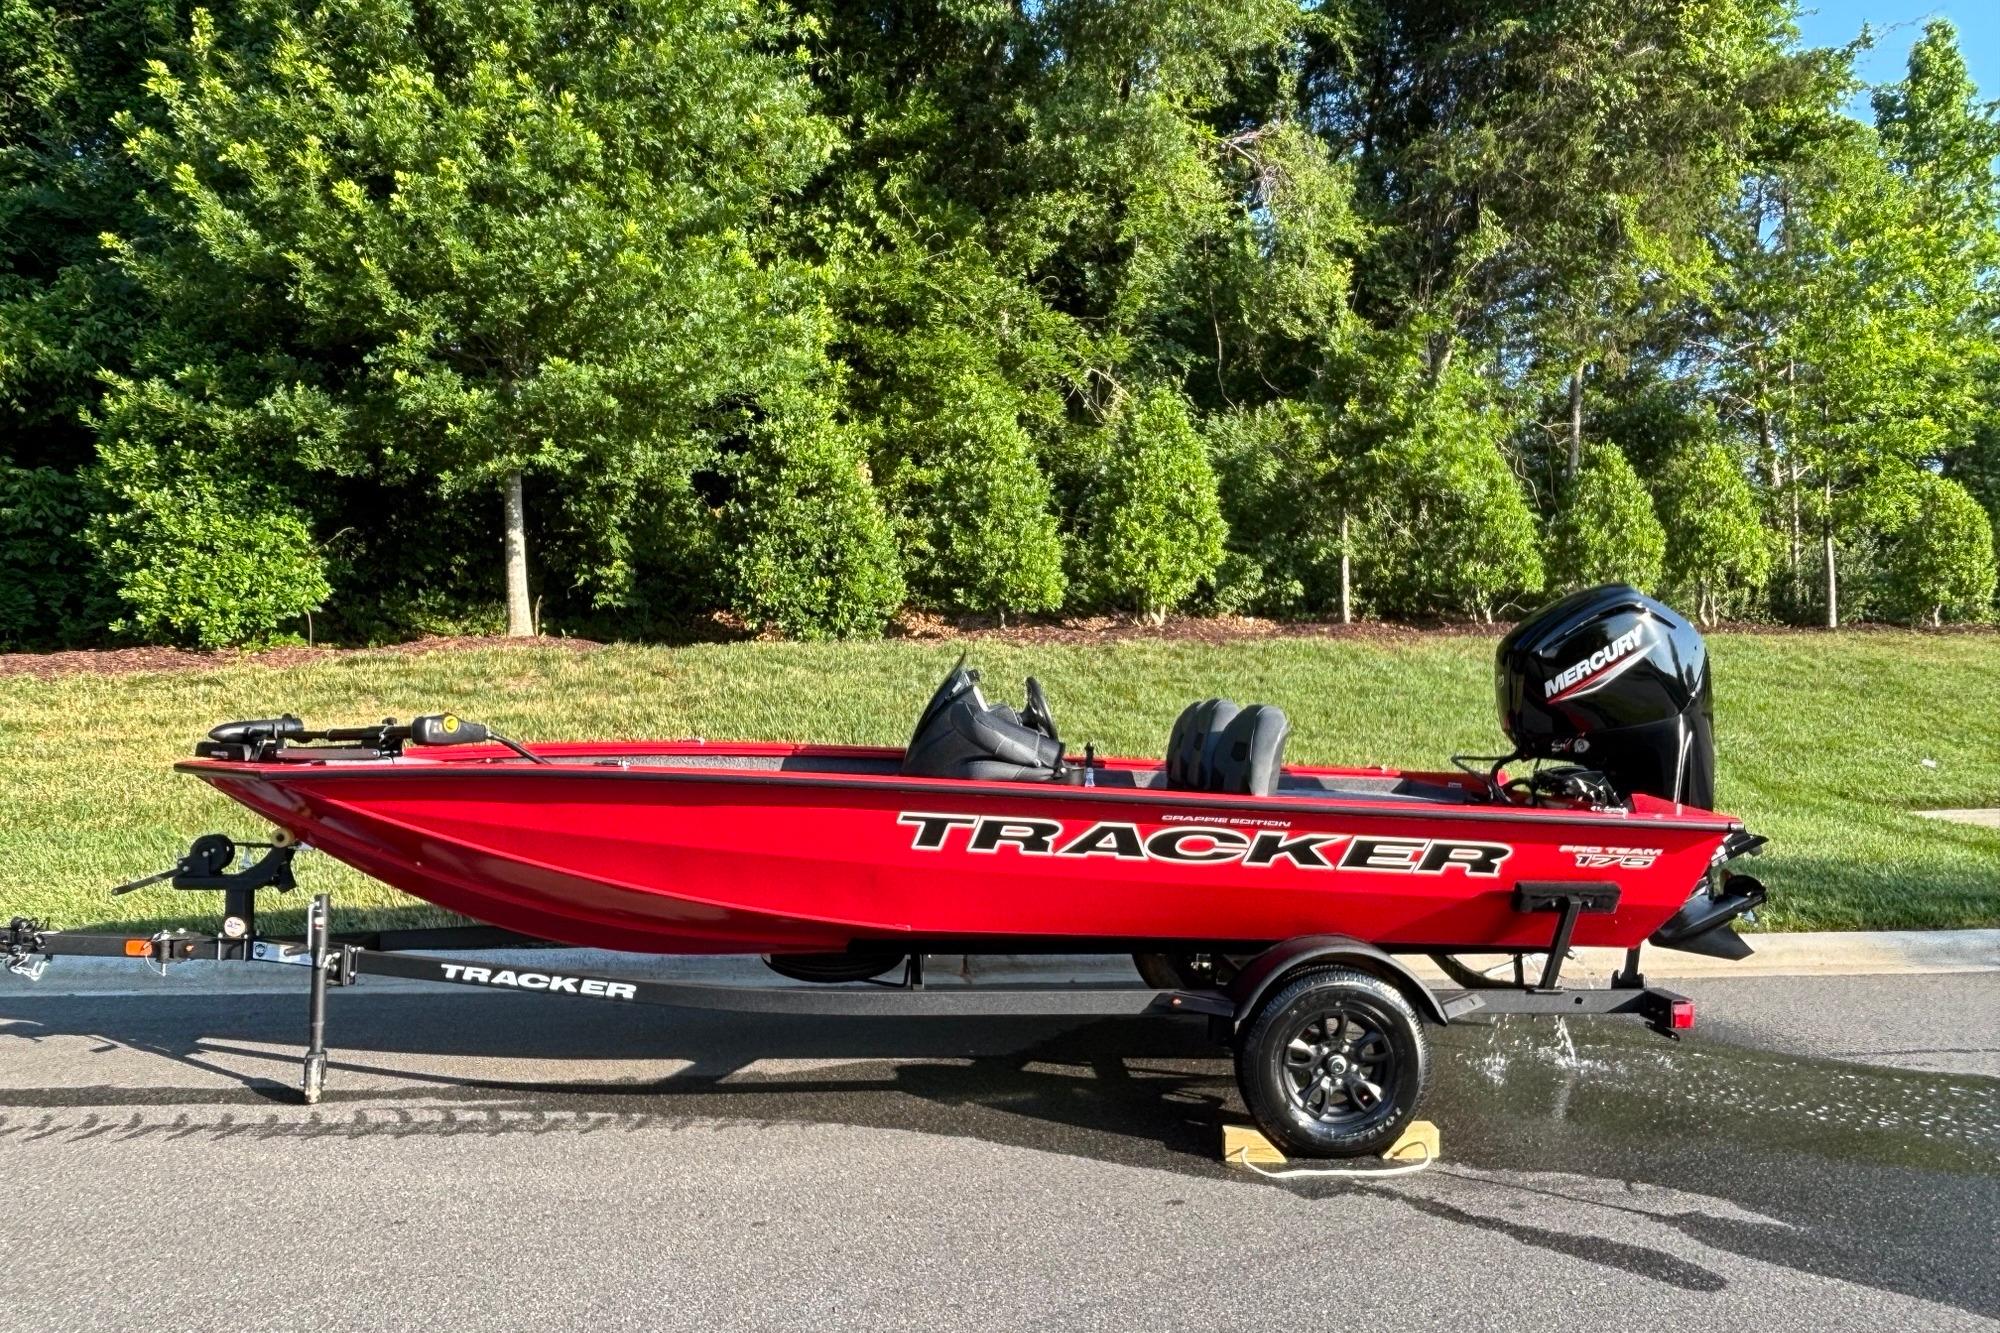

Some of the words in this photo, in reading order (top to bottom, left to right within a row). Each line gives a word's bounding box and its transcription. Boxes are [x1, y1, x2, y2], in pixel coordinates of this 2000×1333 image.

[1544, 623, 1643, 698] MERCURY
[1229, 818, 1292, 828] EDITION
[896, 811, 1513, 877] TRACKER
[1558, 845, 1603, 854] PRO
[1605, 847, 1664, 857] TEAM
[1575, 853, 1657, 869] 175
[440, 963, 637, 1000] TRACKER
